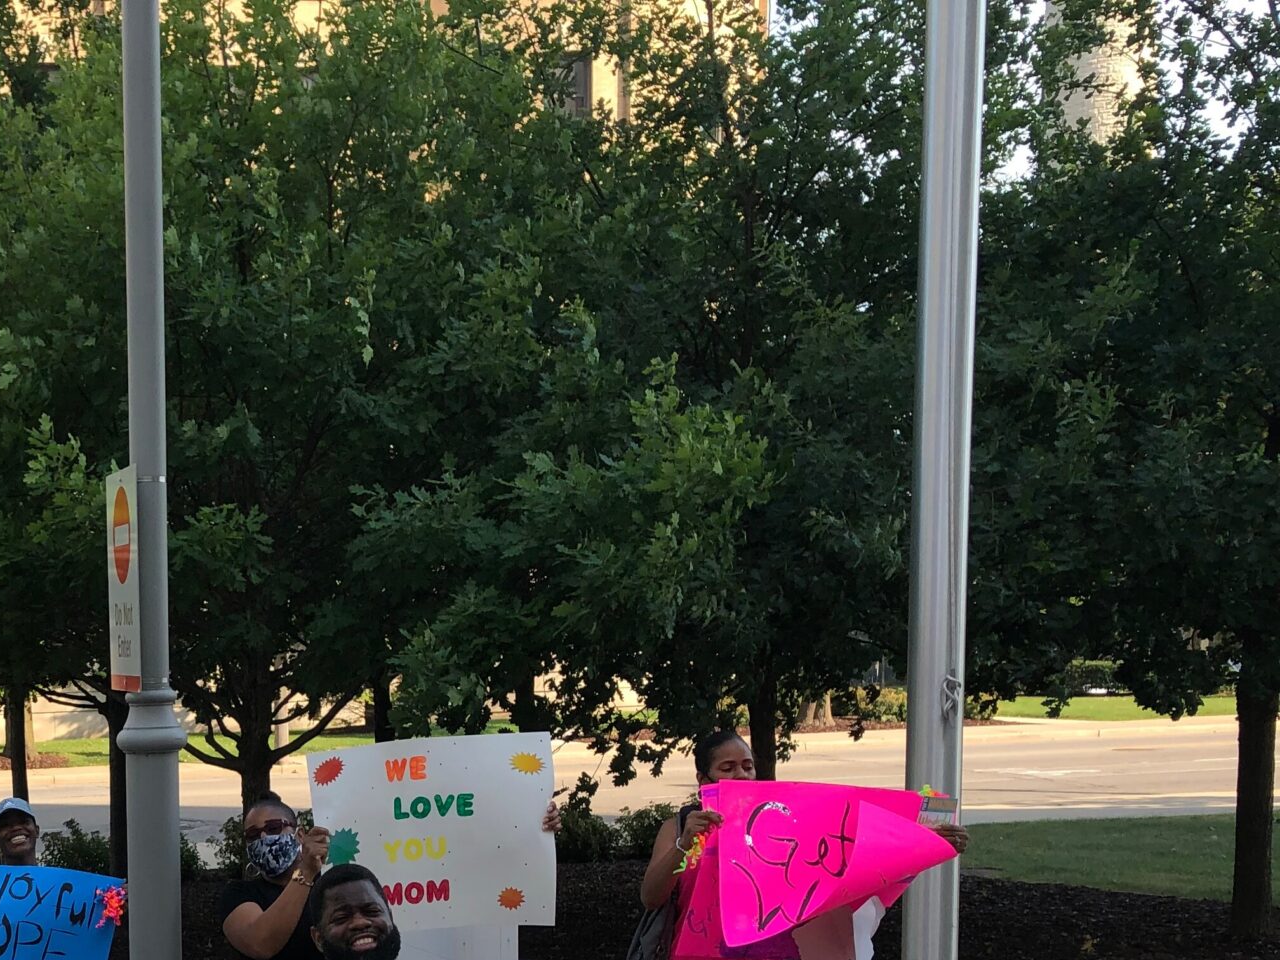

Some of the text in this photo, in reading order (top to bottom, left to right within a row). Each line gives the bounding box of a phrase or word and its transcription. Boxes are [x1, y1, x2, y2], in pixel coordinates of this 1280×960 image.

[385, 755, 427, 782] WE
[394, 793, 474, 820] LOVE
[384, 835, 447, 864] YOU
[744, 800, 856, 888] Get
[382, 879, 450, 906] MOM
